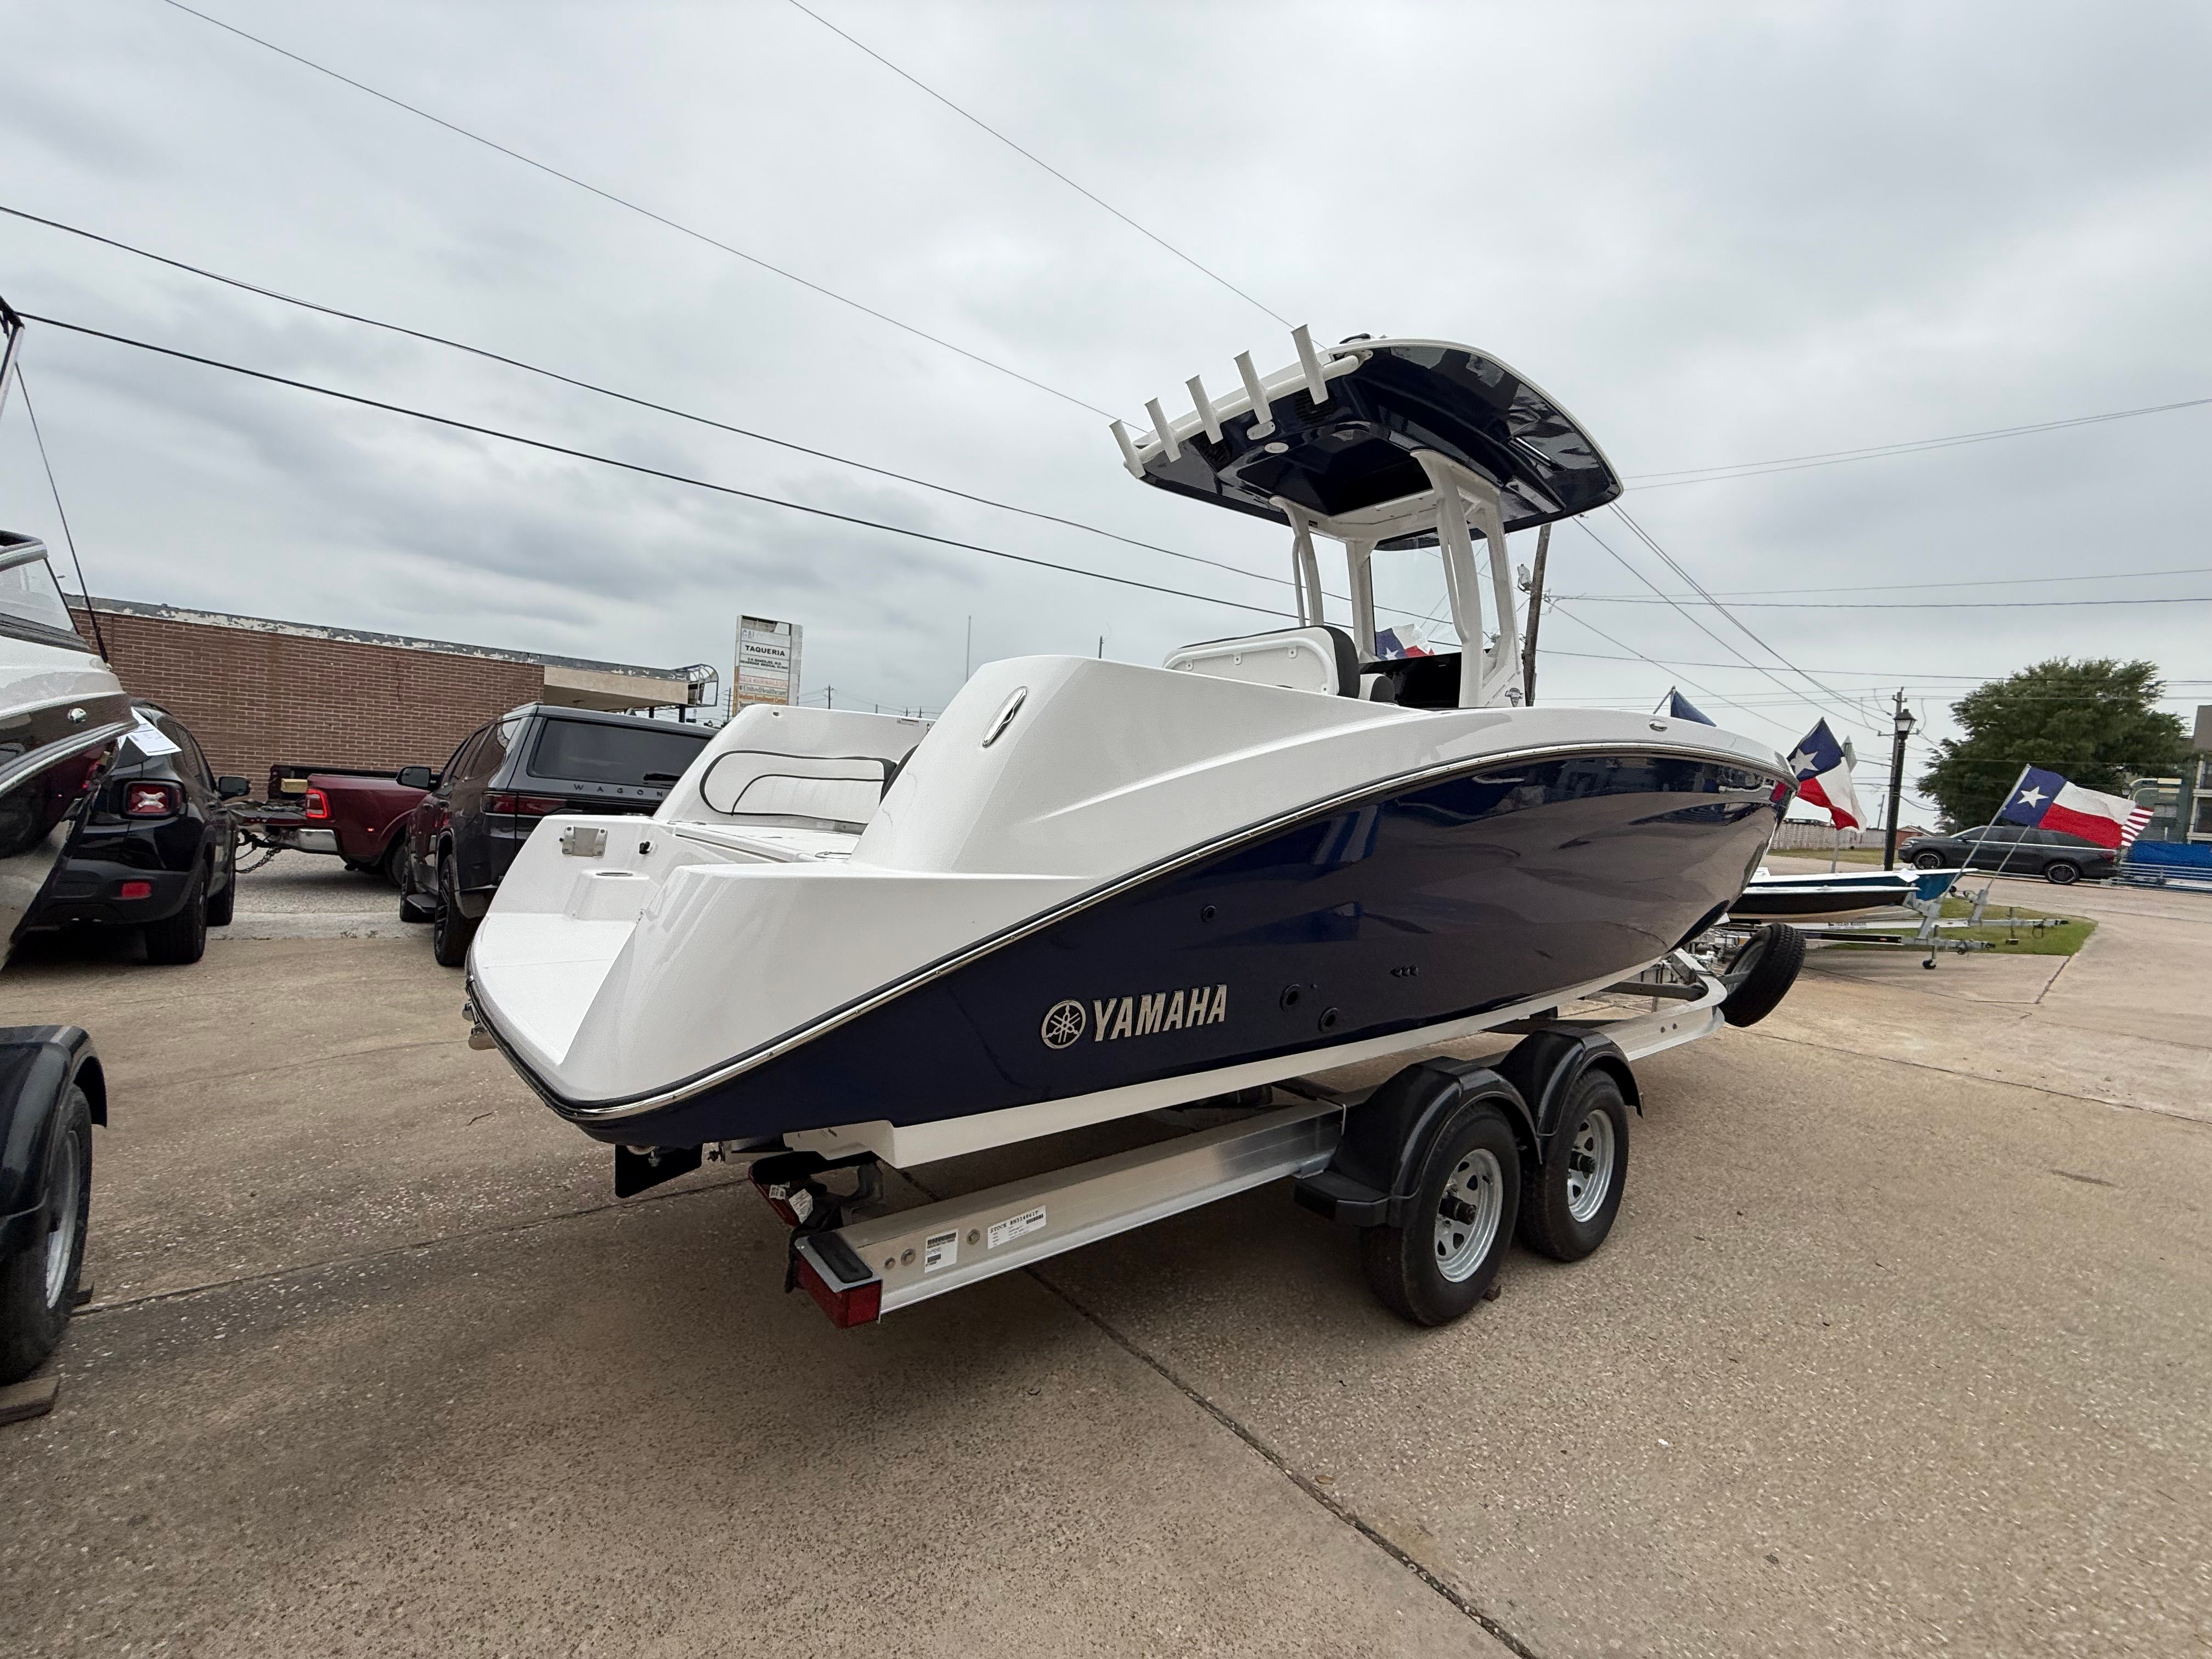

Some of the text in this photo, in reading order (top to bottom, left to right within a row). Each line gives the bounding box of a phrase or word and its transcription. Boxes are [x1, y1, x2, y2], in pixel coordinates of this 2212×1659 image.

[745, 645, 785, 656] TAQUERIA
[1093, 984, 1227, 1042] YAMAHA
[990, 1223, 1007, 1233] STOCK
